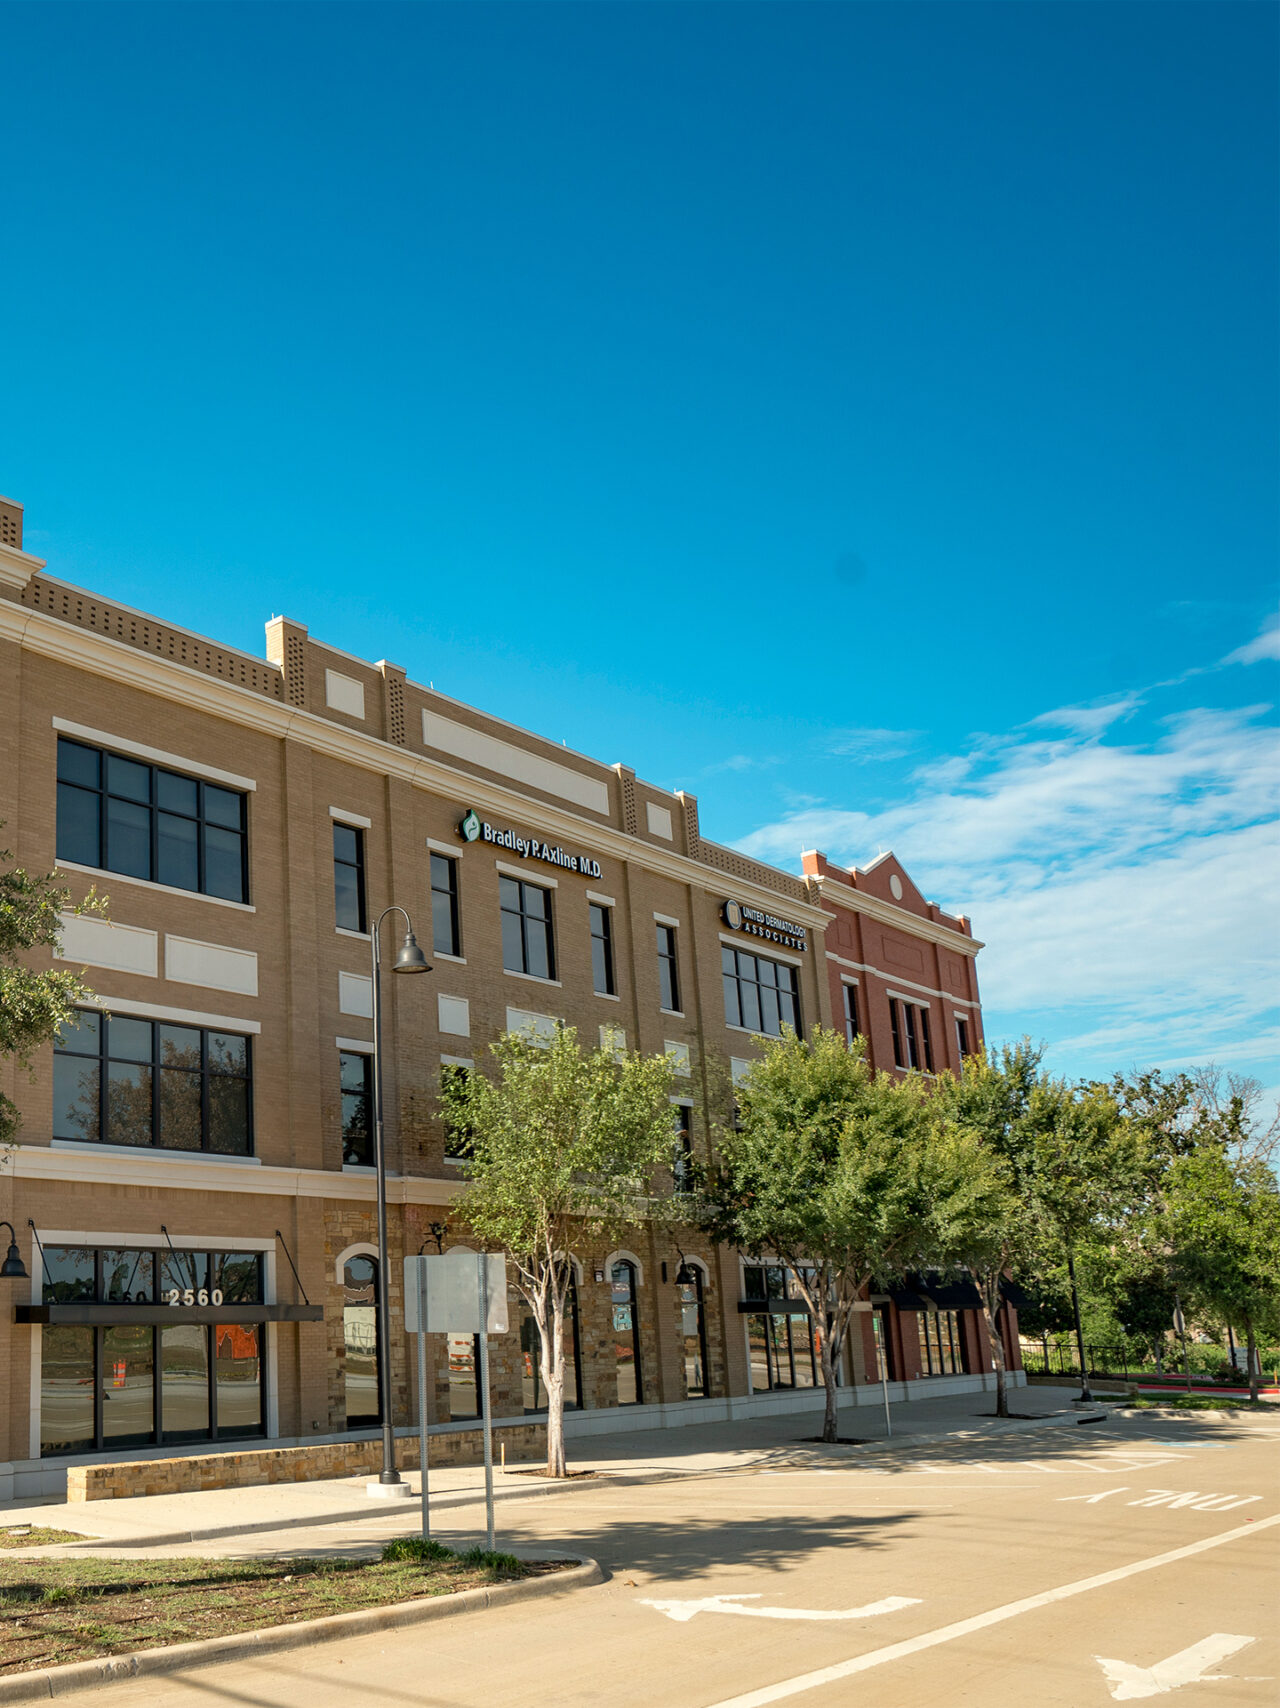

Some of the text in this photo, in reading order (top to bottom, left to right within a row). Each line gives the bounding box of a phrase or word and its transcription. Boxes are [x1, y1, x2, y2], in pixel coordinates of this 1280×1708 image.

[483, 822, 603, 879] Bradley P. Axline M.D.
[742, 906, 807, 938] UNITED DERMATOLOGY
[744, 922, 808, 952] ASSOCIATES
[169, 1288, 223, 1307] 2560
